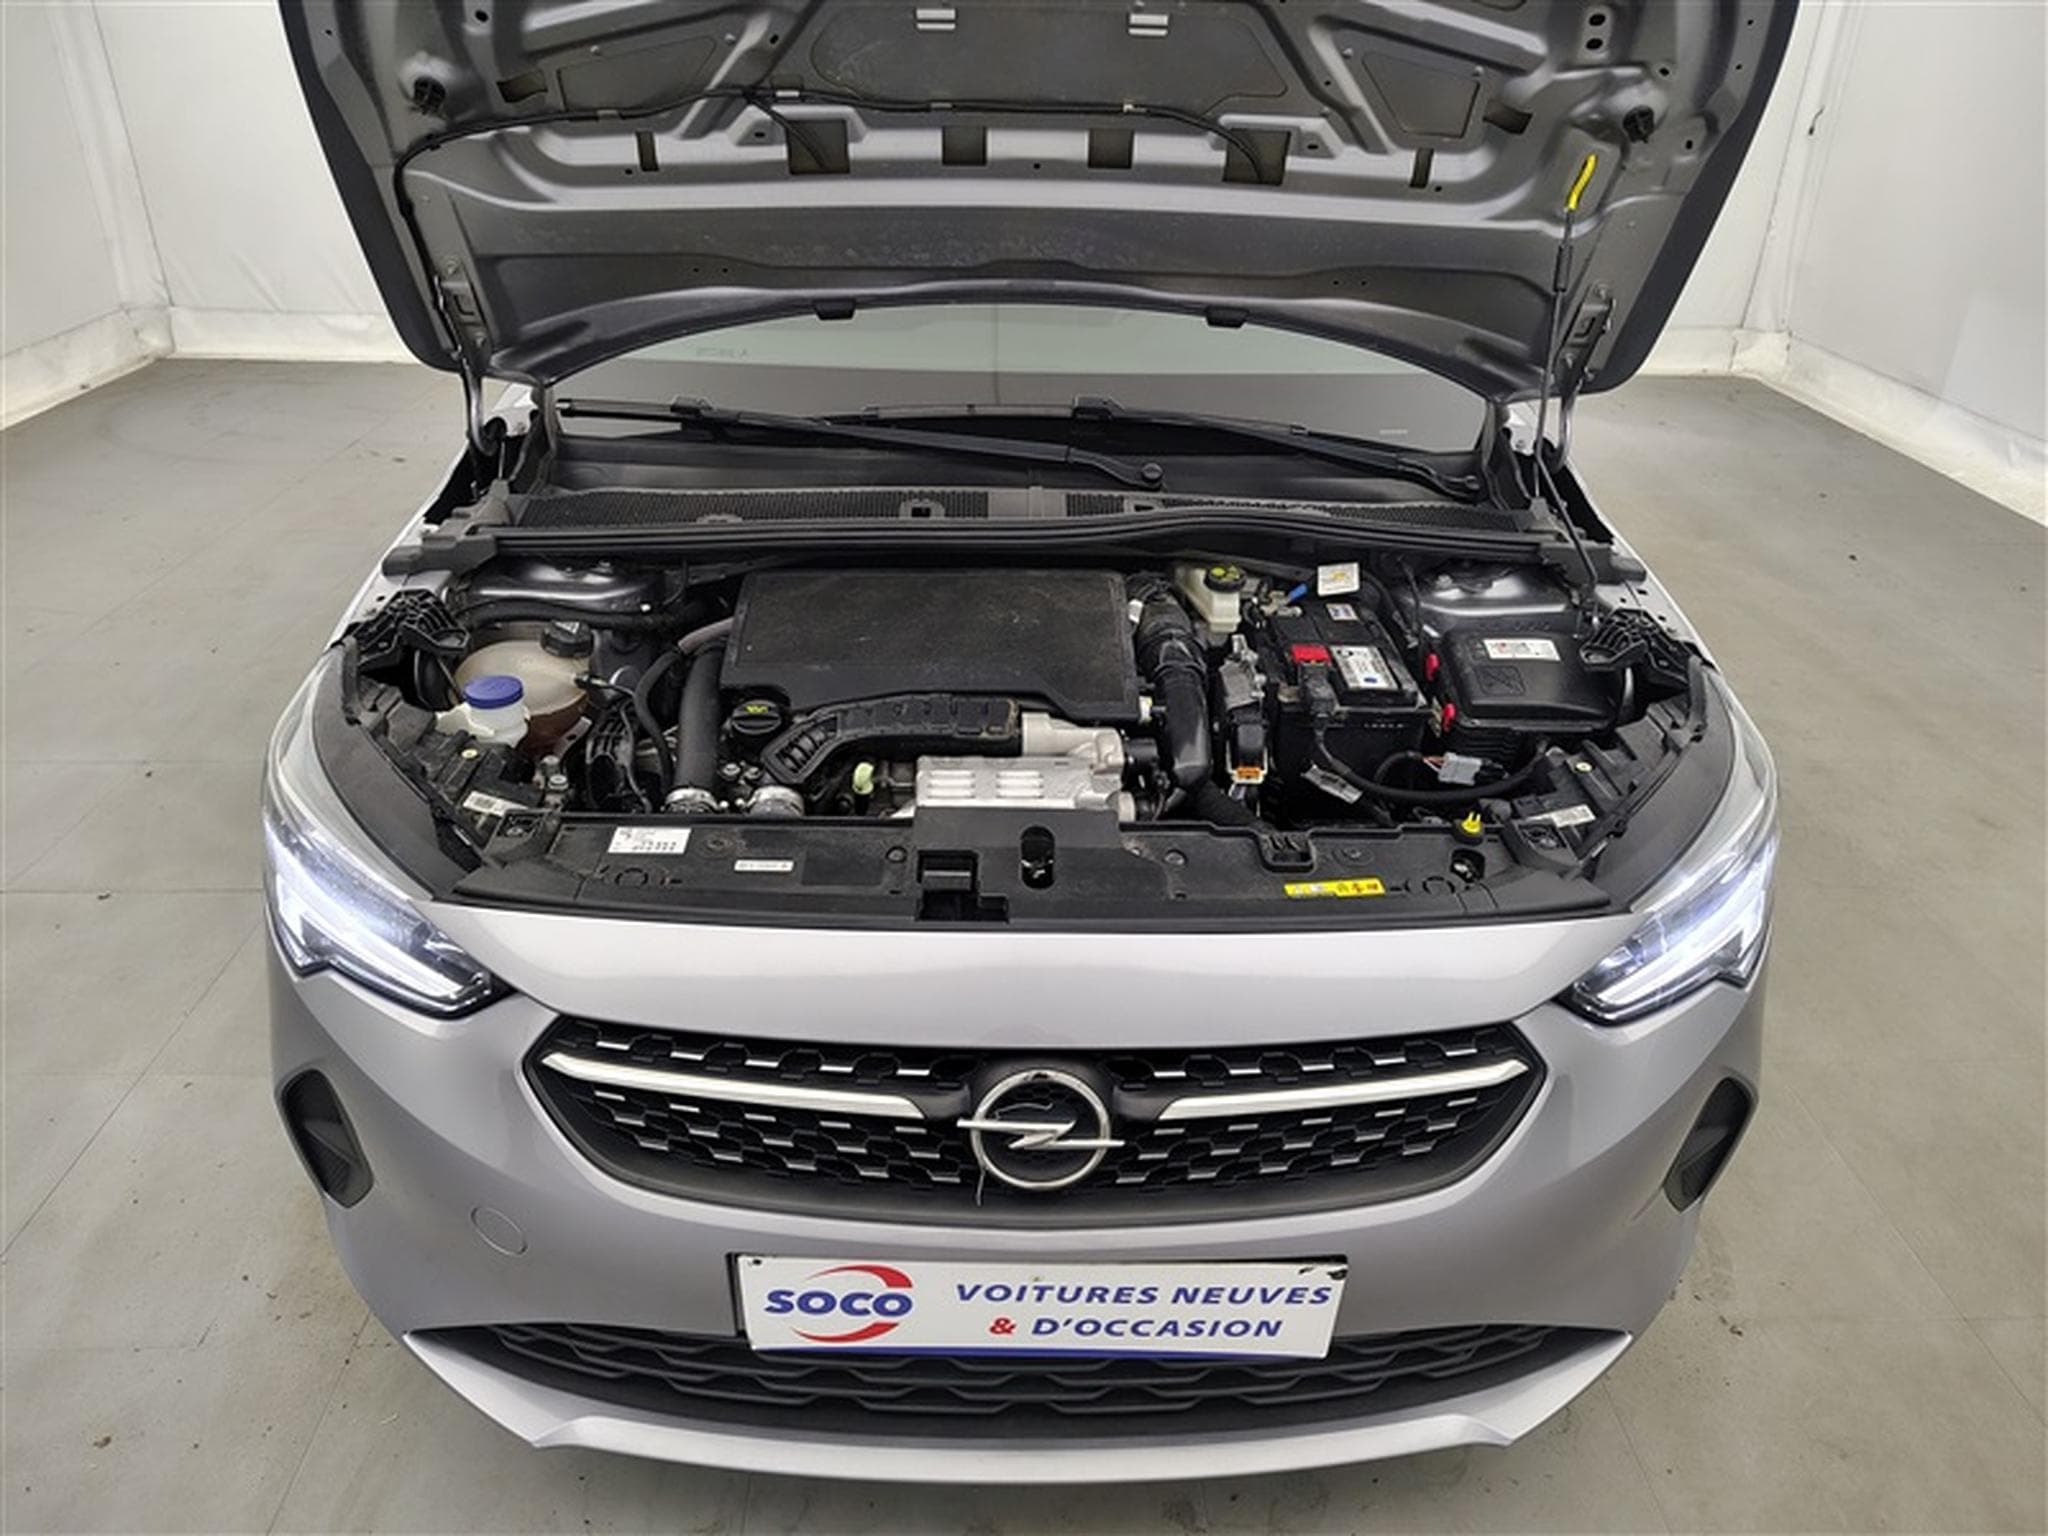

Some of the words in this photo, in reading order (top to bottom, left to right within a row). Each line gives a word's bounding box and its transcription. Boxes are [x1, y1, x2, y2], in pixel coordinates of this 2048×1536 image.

[764, 1289, 913, 1317] SOCO
[956, 1284, 1159, 1304] VOITURES
[1171, 1287, 1333, 1305] NEUVES
[988, 1317, 1017, 1336] &
[1031, 1318, 1283, 1338] D'OCCASION
